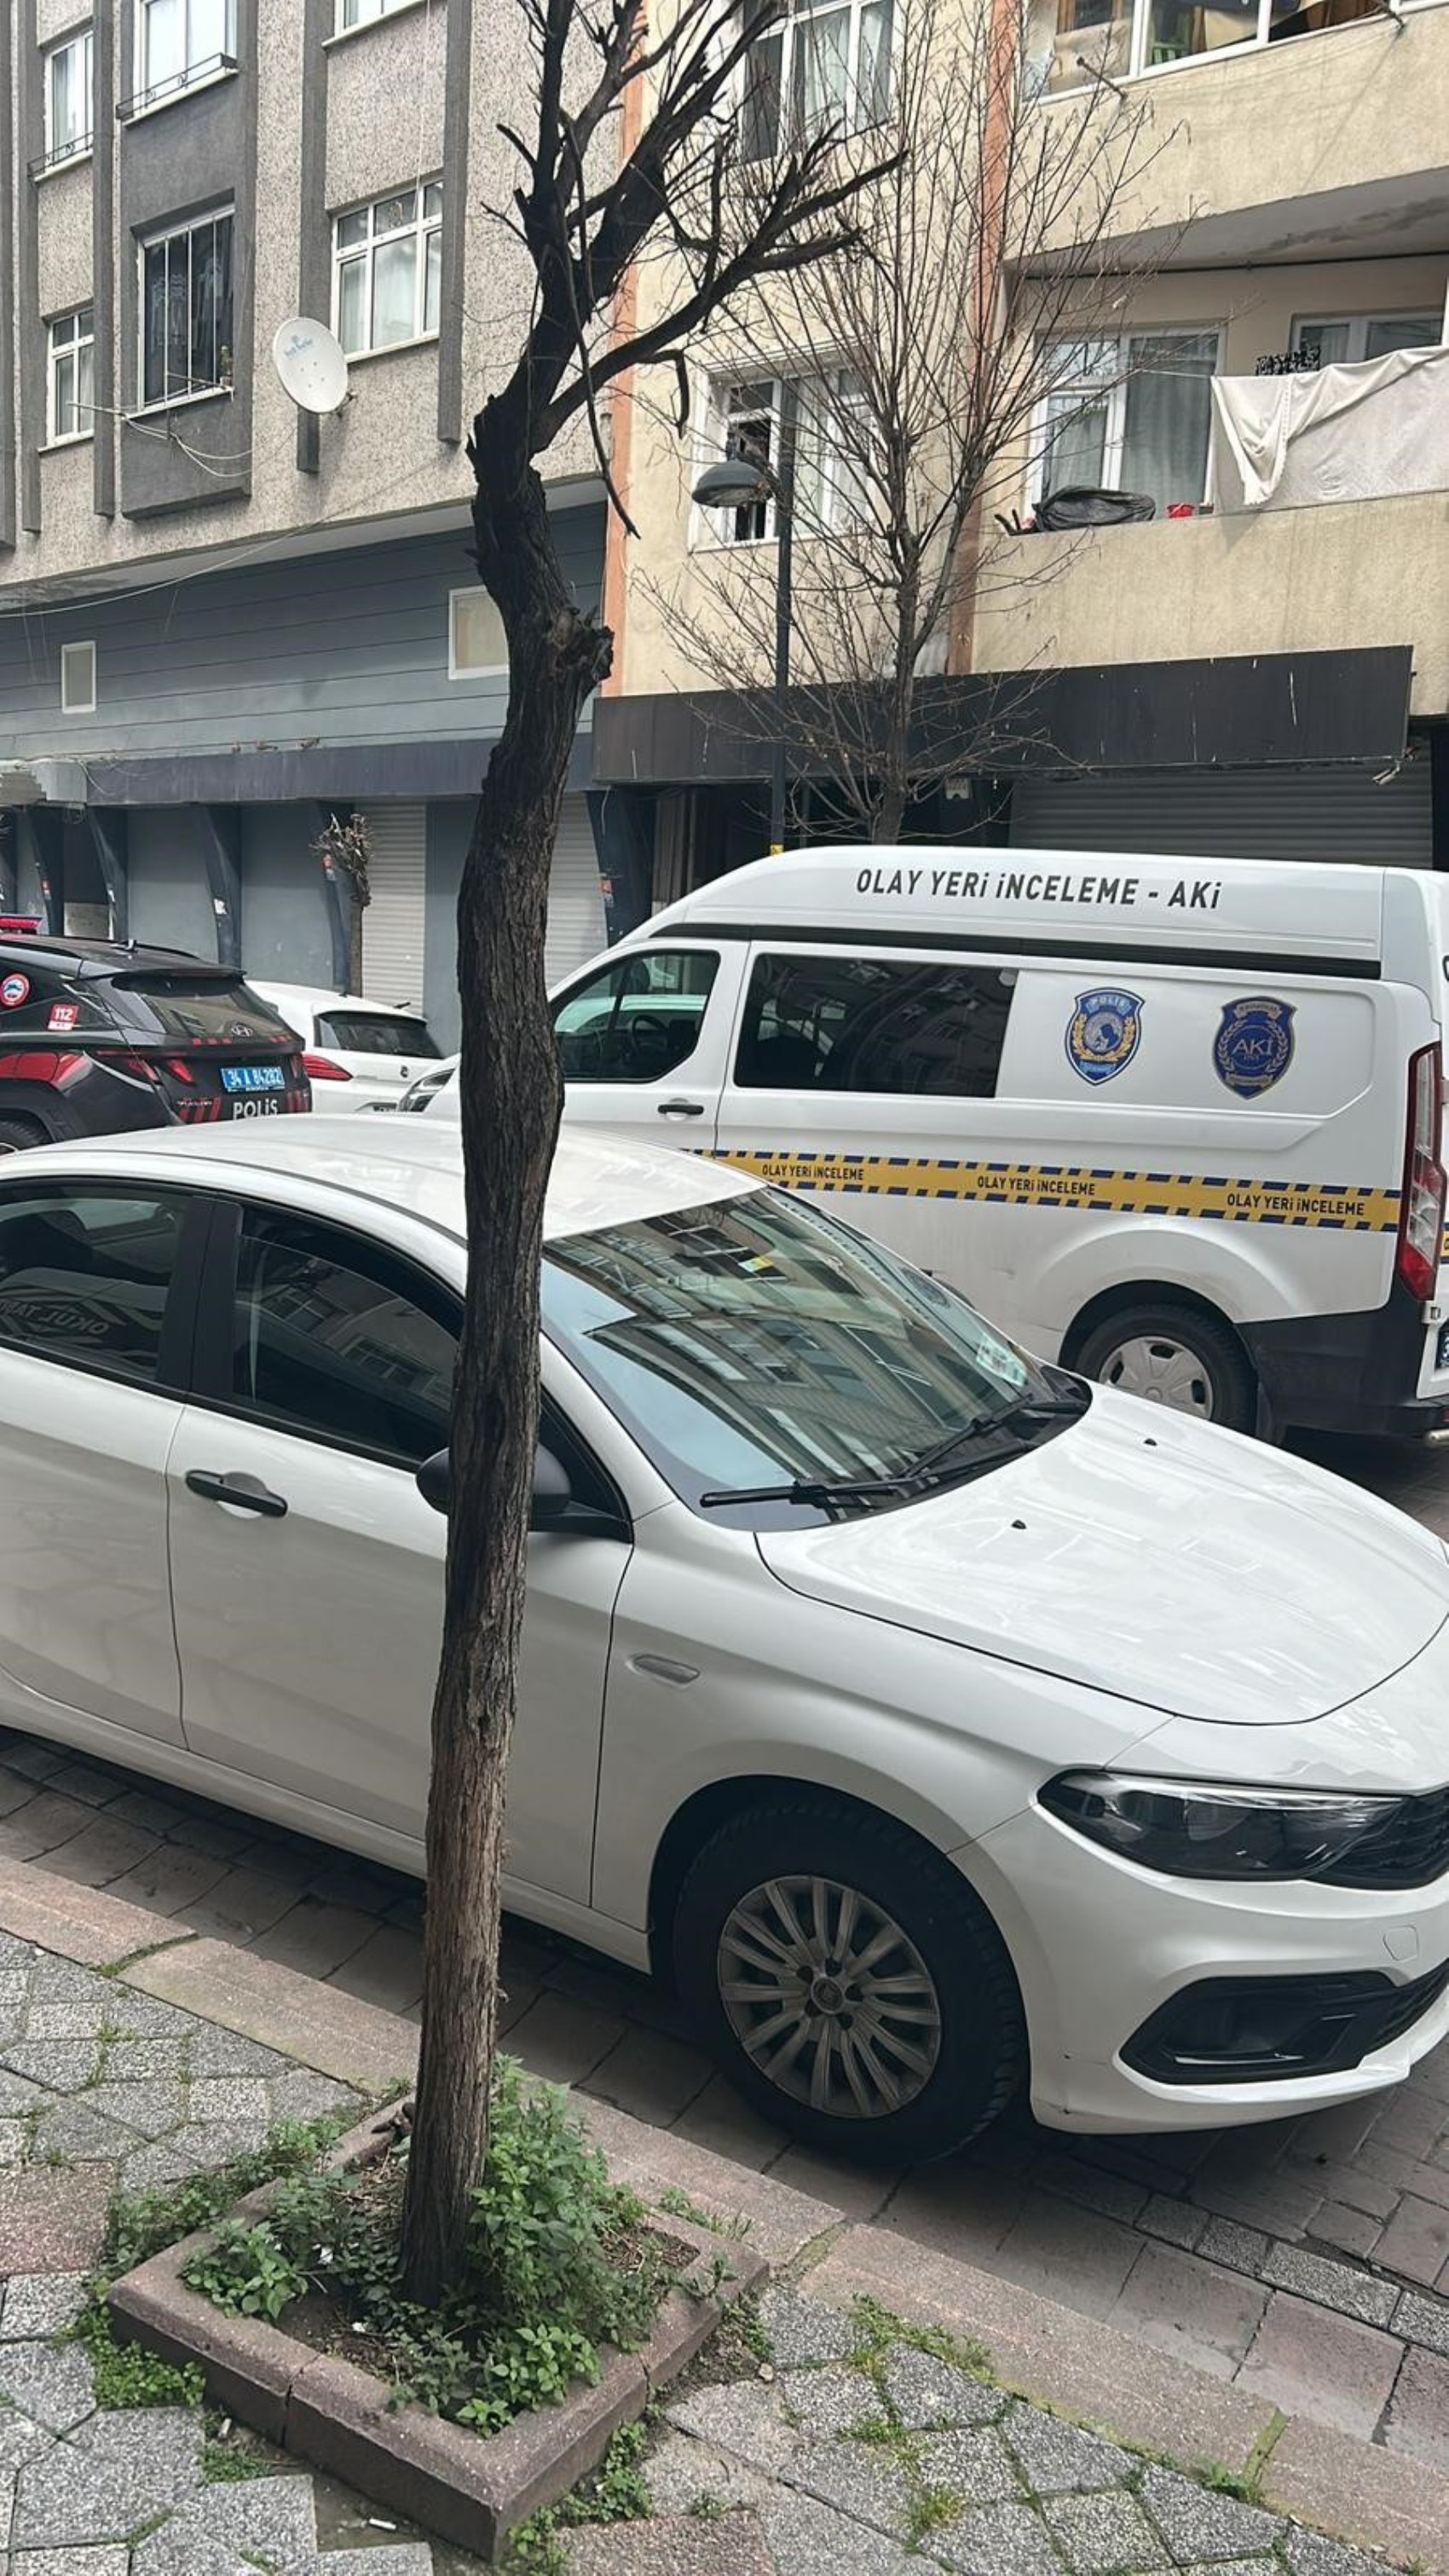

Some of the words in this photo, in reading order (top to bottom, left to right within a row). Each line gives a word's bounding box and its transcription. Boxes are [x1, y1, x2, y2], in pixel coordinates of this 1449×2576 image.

[857, 869, 923, 894] OLAY
[54, 1007, 74, 1021] 112
[762, 1164, 788, 1176] OLAY
[977, 1175, 1007, 1190] OLAY
[1227, 1193, 1261, 1209] OLAY
